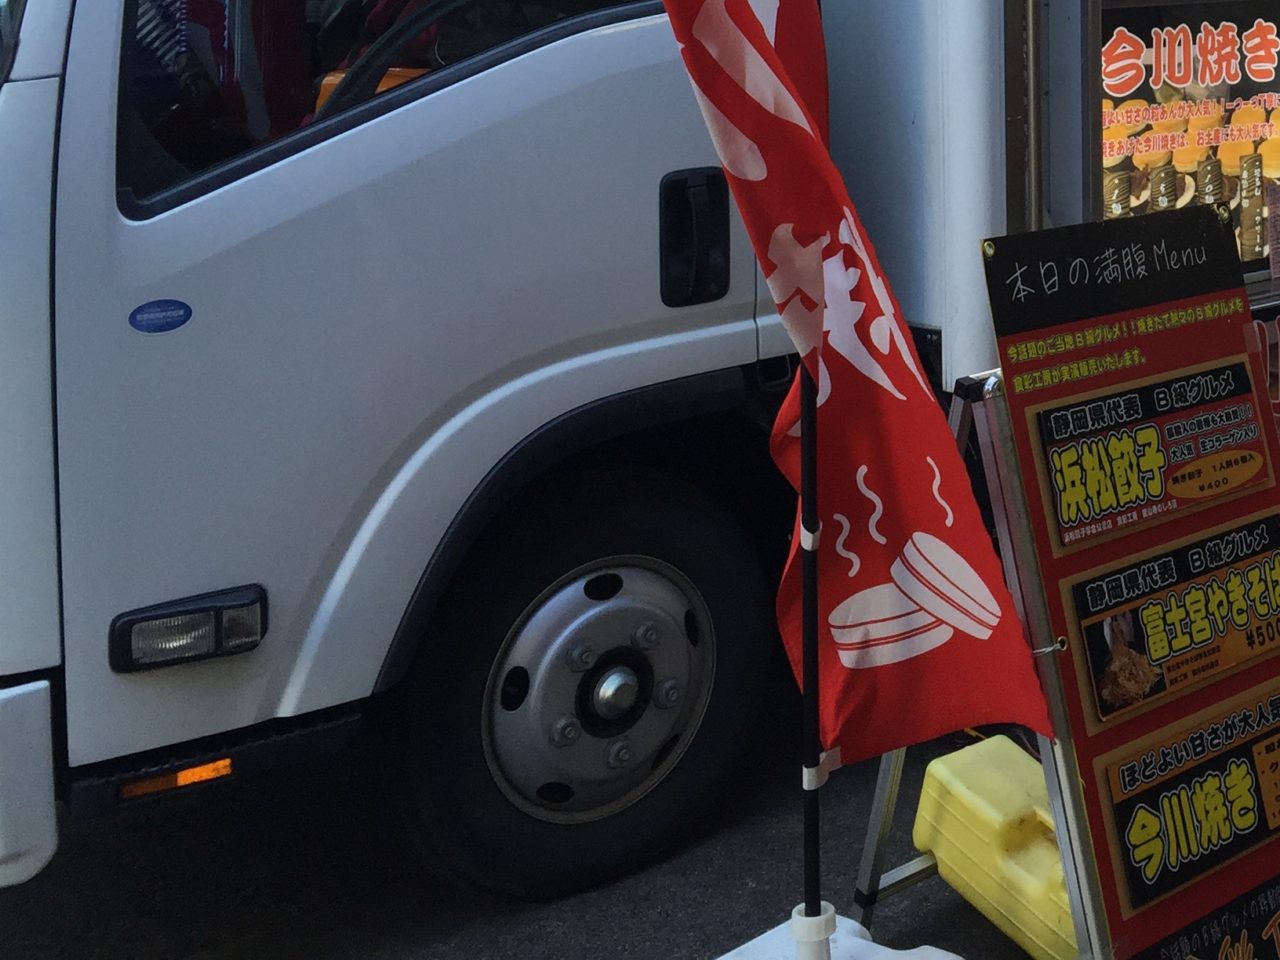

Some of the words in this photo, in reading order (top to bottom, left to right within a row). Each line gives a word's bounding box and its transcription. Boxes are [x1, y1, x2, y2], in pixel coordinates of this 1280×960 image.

[1005, 243, 1149, 303] 本日の満腹
[1152, 239, 1208, 272] Menu
[1050, 394, 1142, 439] 静岡県代表
[1154, 370, 1236, 411] B級グルメ
[1050, 422, 1169, 529] 浜松餃子
[1086, 556, 1177, 612] 静岡県代表
[1189, 524, 1269, 573] B級グルメ
[1125, 757, 1258, 885] 今川焼き
